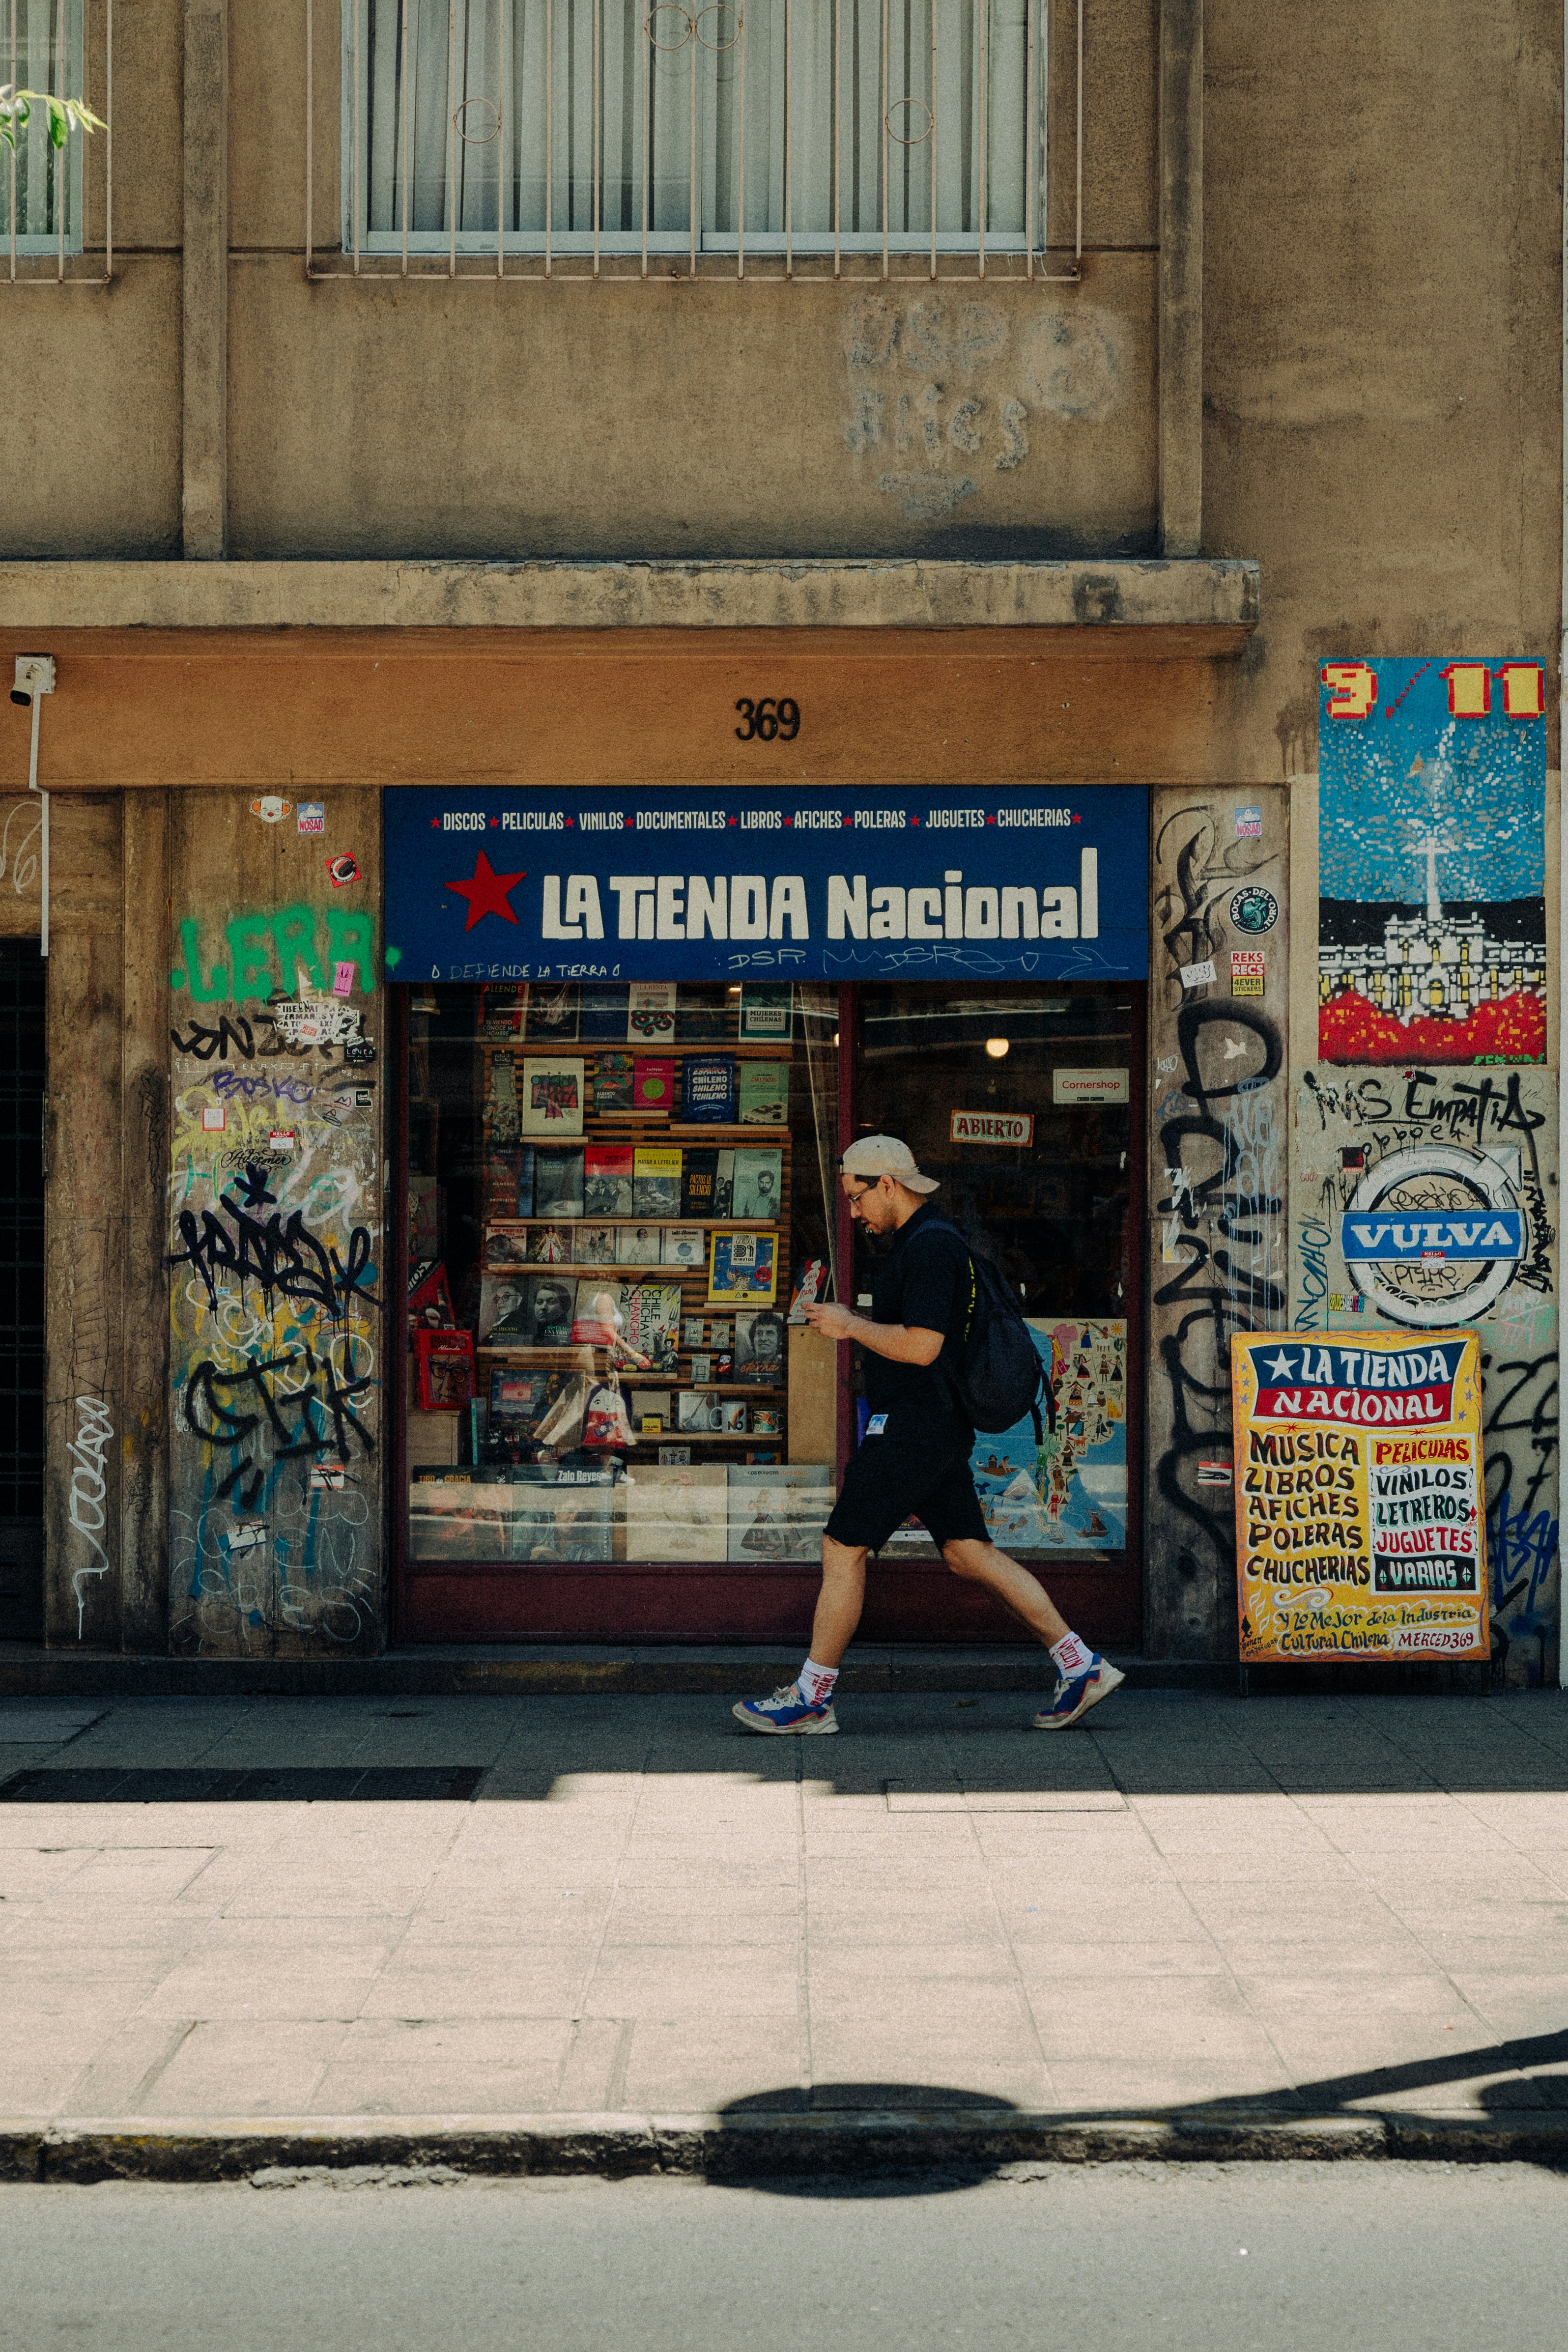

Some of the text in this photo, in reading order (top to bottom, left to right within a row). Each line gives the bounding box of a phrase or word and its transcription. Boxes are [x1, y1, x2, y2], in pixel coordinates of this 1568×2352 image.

[735, 697, 800, 741] 369
[443, 808, 1071, 831] DISCOS PELICULAS VINILOS DOCUMENTALES LIBROS AFICHES POLERAS JUGUETES CHUCHERIAS
[542, 875, 604, 940] LA
[827, 847, 1098, 940] Nacional
[1231, 888, 1277, 927] BOCAS DEL TORO
[1232, 952, 1263, 963] REKS
[537, 964, 550, 977] LA
[1232, 964, 1264, 976] RECS
[484, 985, 523, 993] ALLENDE
[692, 1067, 727, 1076] ESPAÑOL
[692, 1084, 727, 1092] SHILENO
[1062, 1080, 1120, 1090] Cornershop
[692, 1093, 727, 1101] TCHILENO
[957, 1117, 1024, 1138] ABIERTO
[689, 1185, 712, 1196] SILENCIO
[690, 1174, 712, 1184] PACTOS DE
[1350, 1220, 1513, 1252] VULVA
[734, 1245, 754, 1258] 31
[629, 1289, 641, 1345] CHANCHO
[640, 1289, 652, 1332] CHICHA
[740, 1362, 779, 1373] eterna
[1301, 1347, 1336, 1384] LA
[728, 1420, 744, 1431] NO
[1249, 1429, 1360, 1467] MUSICA
[1375, 1439, 1470, 1464] PELICULAS
[419, 1475, 435, 1483] TIRO
[444, 1475, 471, 1483] GRACIA
[558, 1470, 601, 1482] Zalo Reyes
[1244, 1464, 1355, 1496] LIBROS
[1375, 1467, 1468, 1497] VINILOS
[1249, 1492, 1360, 1522] AFICHES
[1376, 1495, 1470, 1526] LETREROS
[1249, 1522, 1364, 1551] POLERAS
[1376, 1527, 1473, 1553] JUGUETES
[1246, 1555, 1370, 1586] CHUCHERIAS
[1390, 1559, 1457, 1587] VARIAS
[1342, 1631, 1390, 1650] Chilena
